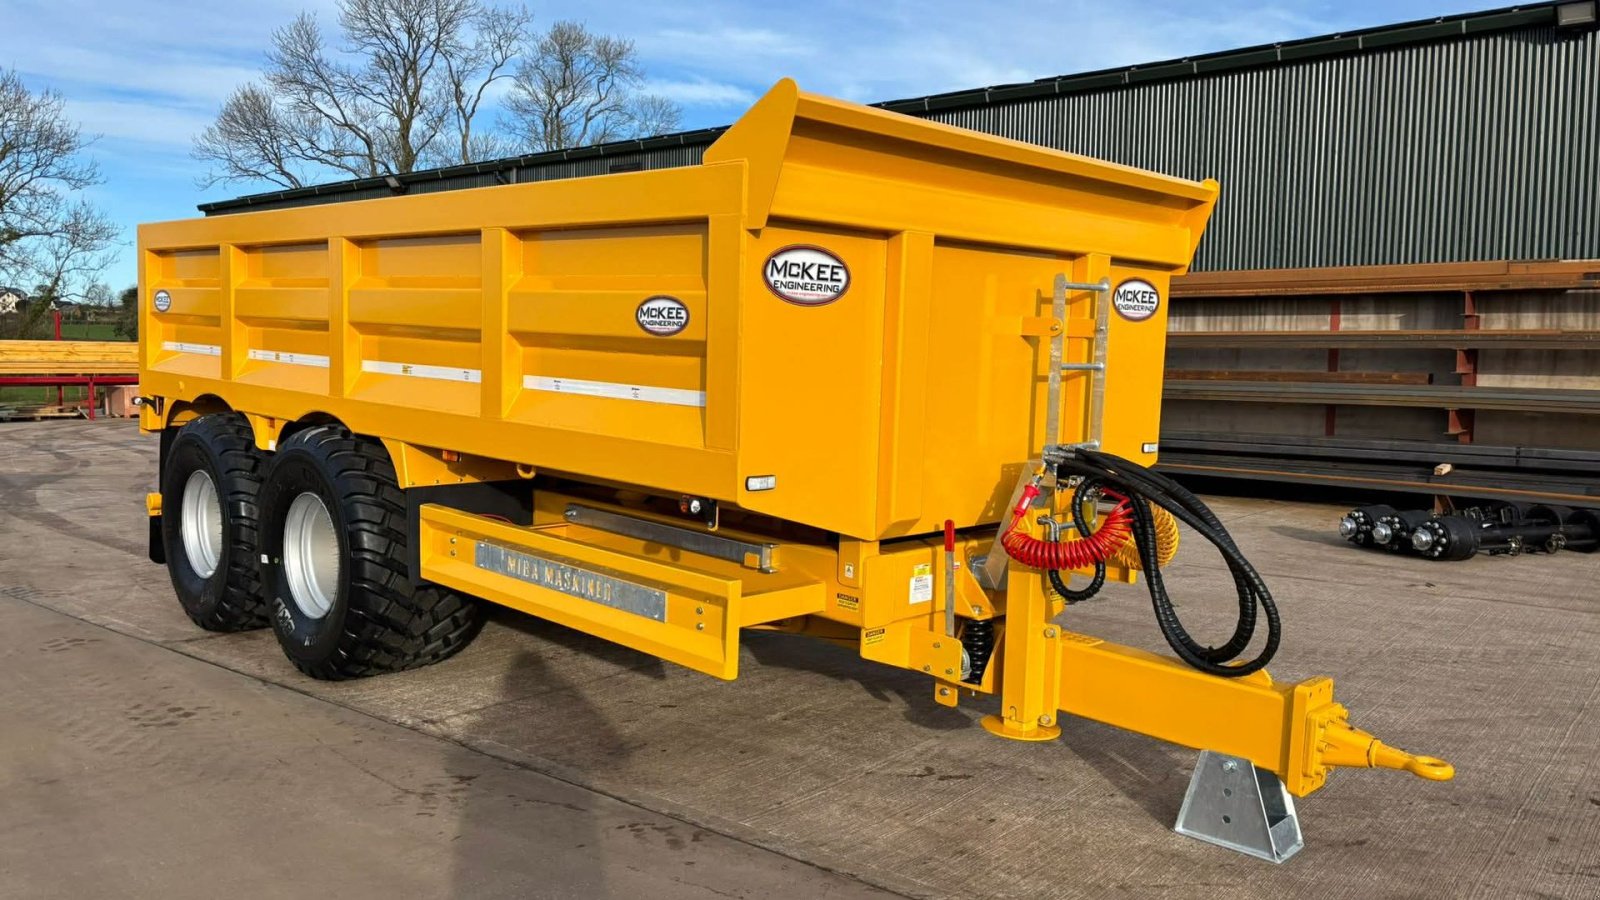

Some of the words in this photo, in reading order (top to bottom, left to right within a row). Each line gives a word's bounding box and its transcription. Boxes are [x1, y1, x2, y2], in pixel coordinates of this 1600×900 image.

[773, 279, 840, 294] ENGINEERING
[1117, 303, 1154, 312] ENGINEERING
[641, 319, 683, 327] ENGINEERING
